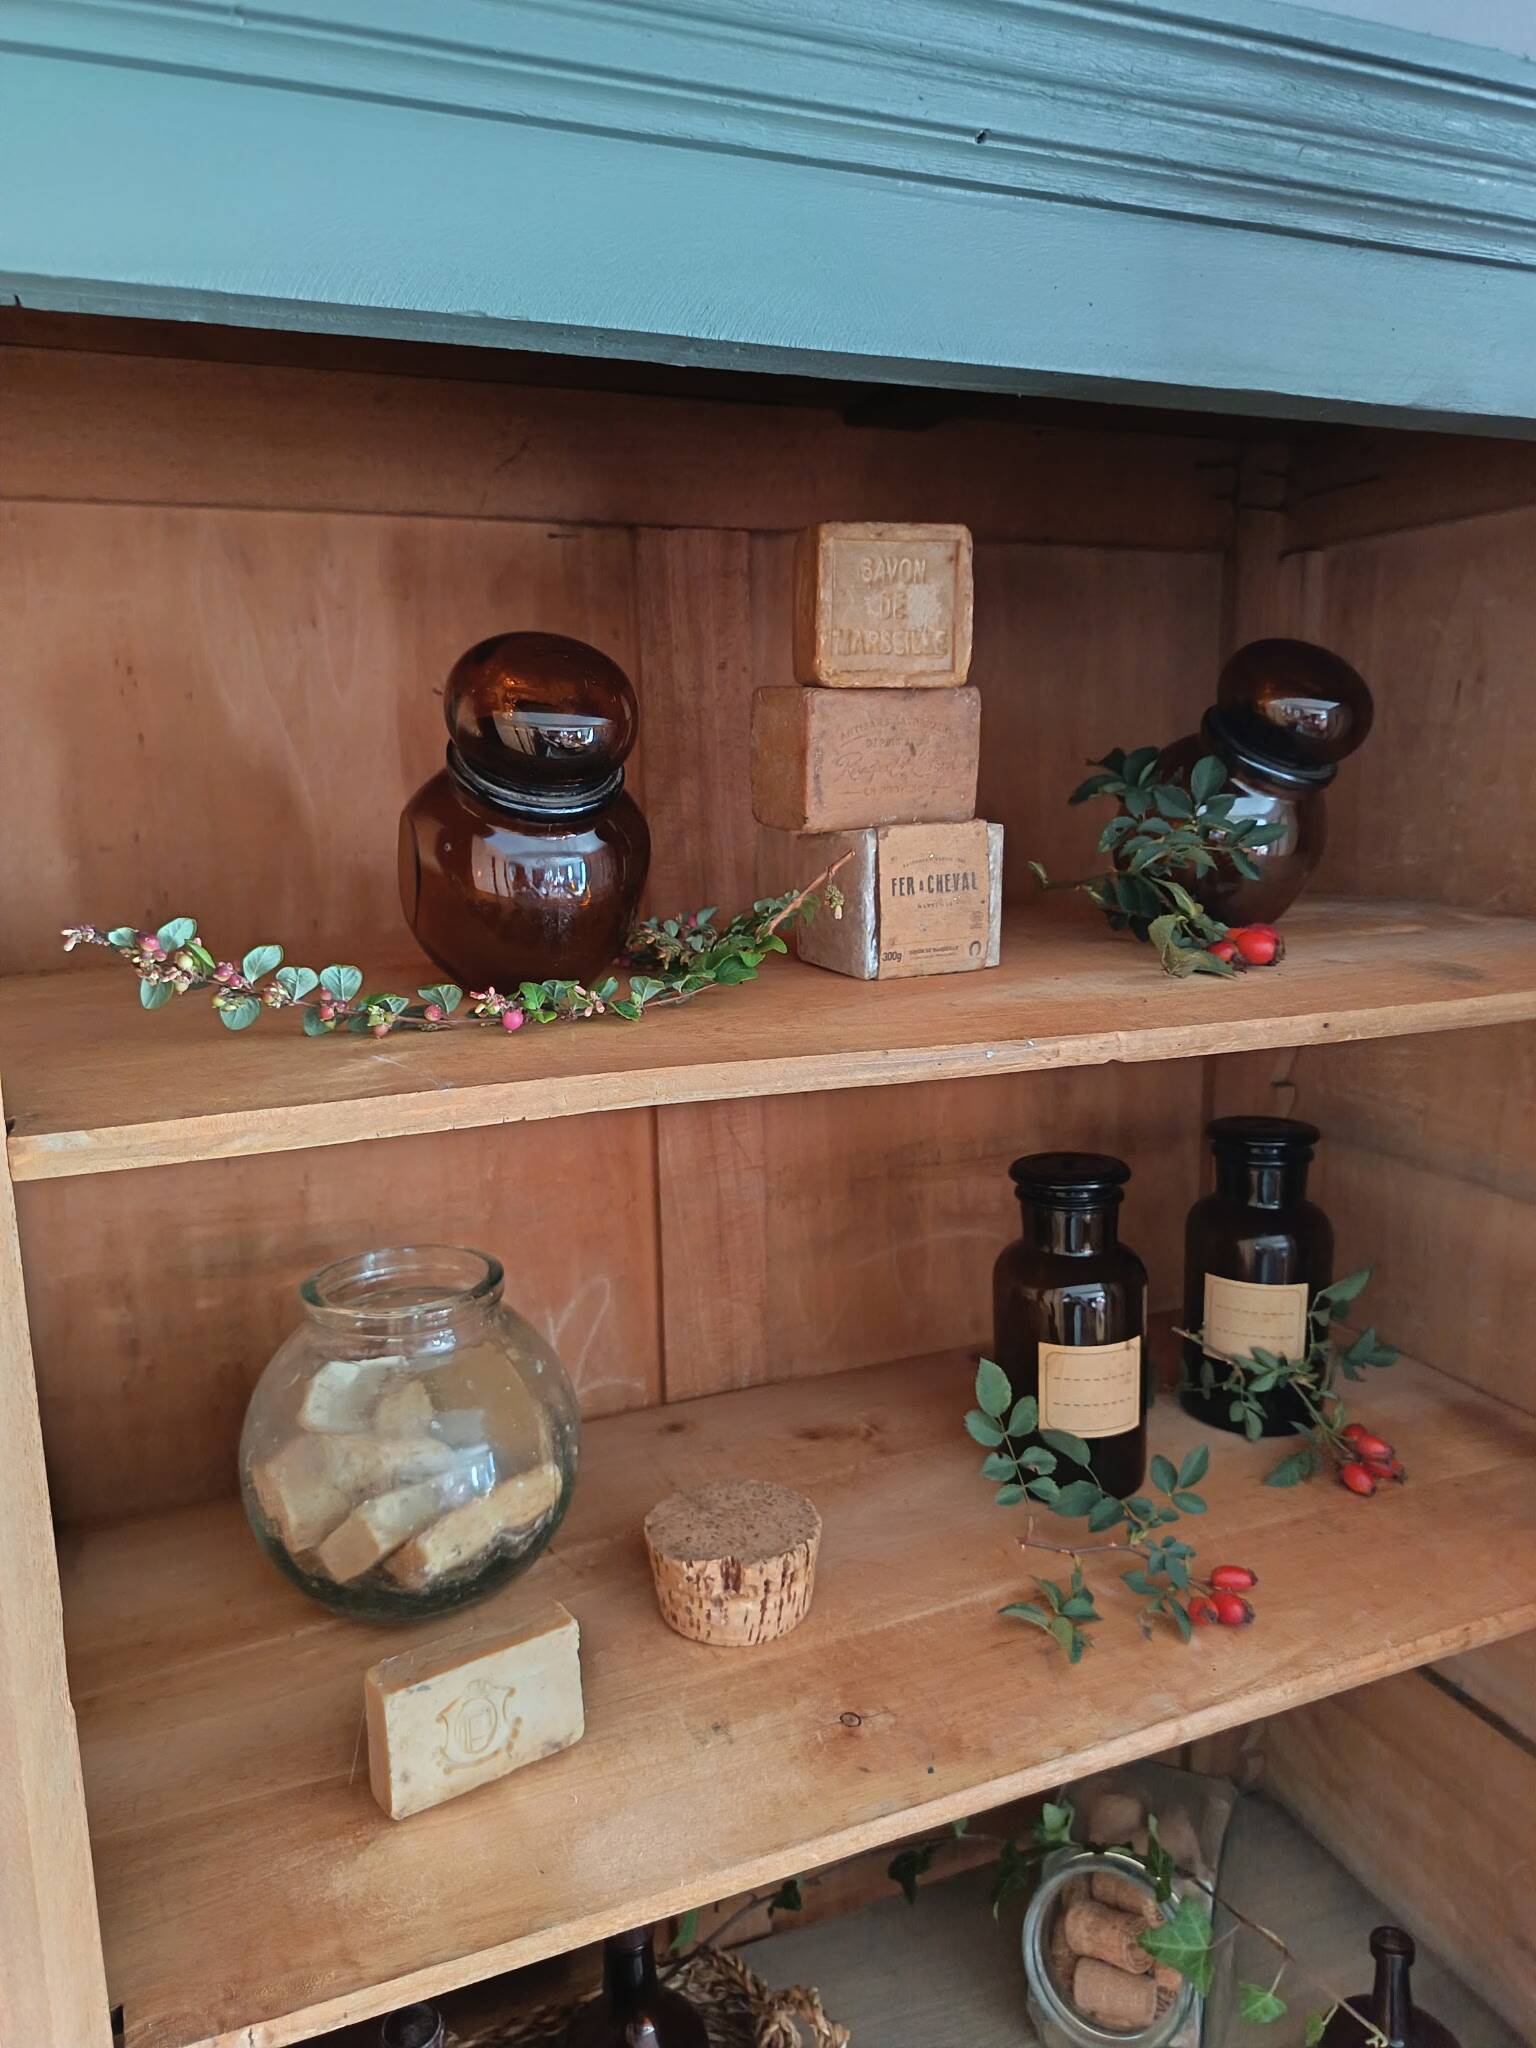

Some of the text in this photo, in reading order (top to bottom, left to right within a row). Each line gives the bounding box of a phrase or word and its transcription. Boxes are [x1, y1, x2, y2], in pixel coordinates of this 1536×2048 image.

[860, 556, 926, 585] SAVON
[879, 589, 908, 620] DE
[892, 877, 915, 896] FER
[928, 872, 977, 893] CHEVAL
[882, 952, 902, 963] 300g
